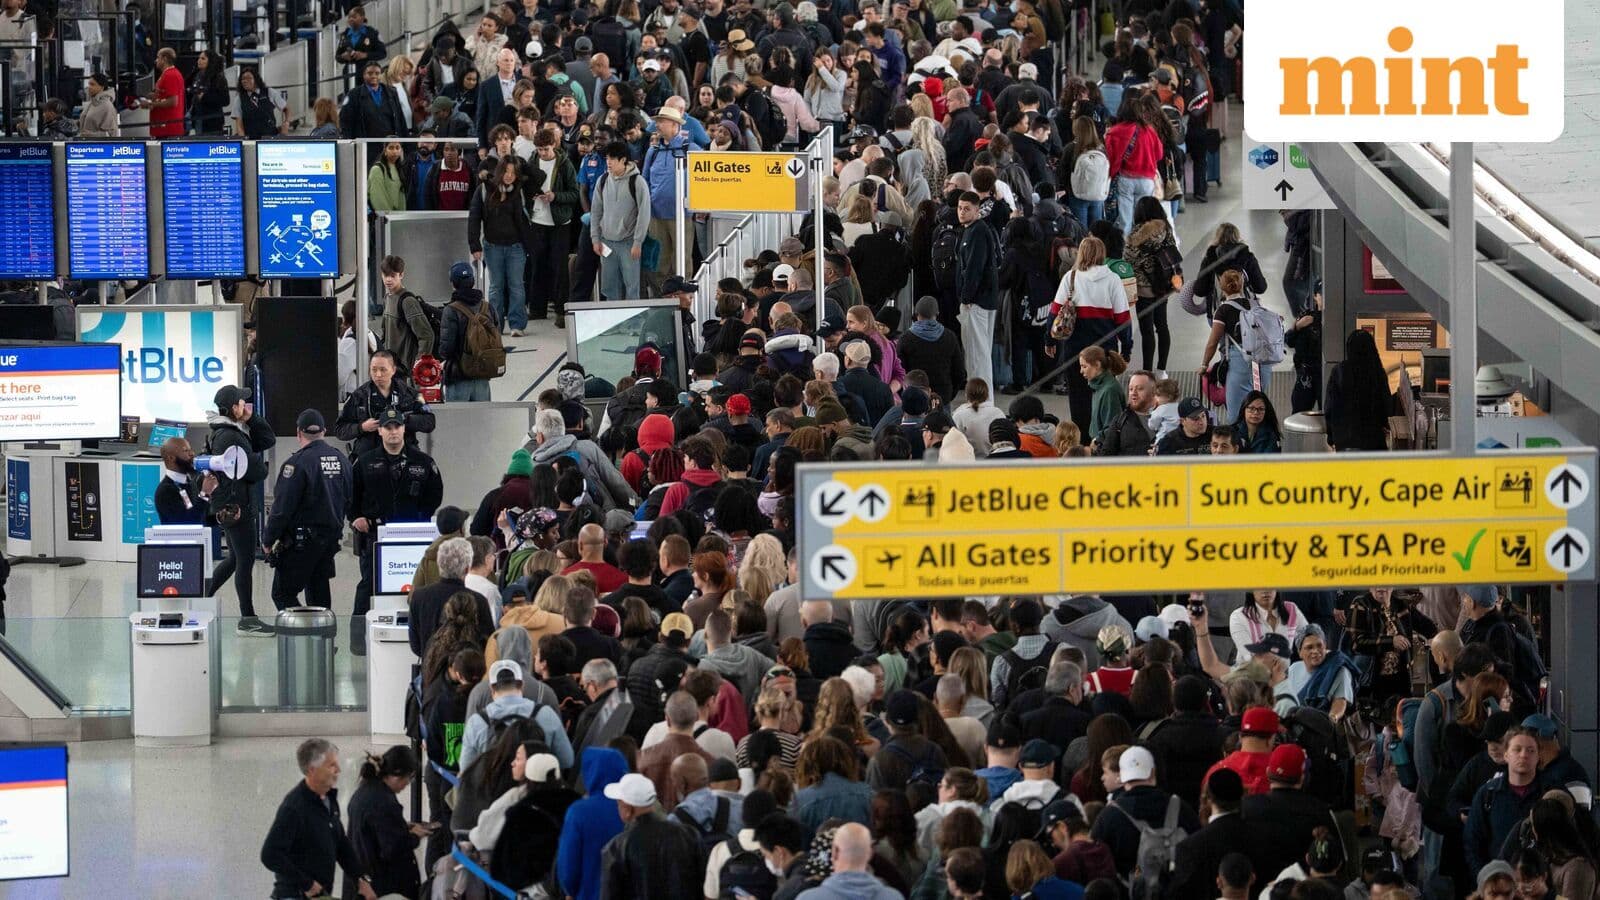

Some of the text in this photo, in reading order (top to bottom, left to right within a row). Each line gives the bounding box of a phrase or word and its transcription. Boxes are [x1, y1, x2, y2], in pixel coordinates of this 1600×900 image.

[19, 147, 48, 158] jetBlue
[69, 146, 105, 154] Departures
[112, 146, 142, 157] jetBlue
[209, 145, 238, 157] jetBlue
[324, 162, 330, 170] 5
[693, 161, 751, 174] All Gates
[440, 181, 469, 191] HARVARD
[10, 381, 42, 394] here
[321, 461, 341, 470] POLICE
[947, 483, 1179, 513] JetBlue Check-in
[1200, 475, 1491, 510] Sun Country, Cape Air
[916, 543, 1051, 568] All Gates
[1071, 532, 1446, 568] Priority Security & TSA Pre
[159, 561, 183, 570] Hello!
[388, 561, 407, 569] Start
[158, 571, 183, 581] ¡Hola!
[1311, 563, 1446, 580] Seguridad Prioritaria
[918, 576, 1029, 588] Todas las puertas
